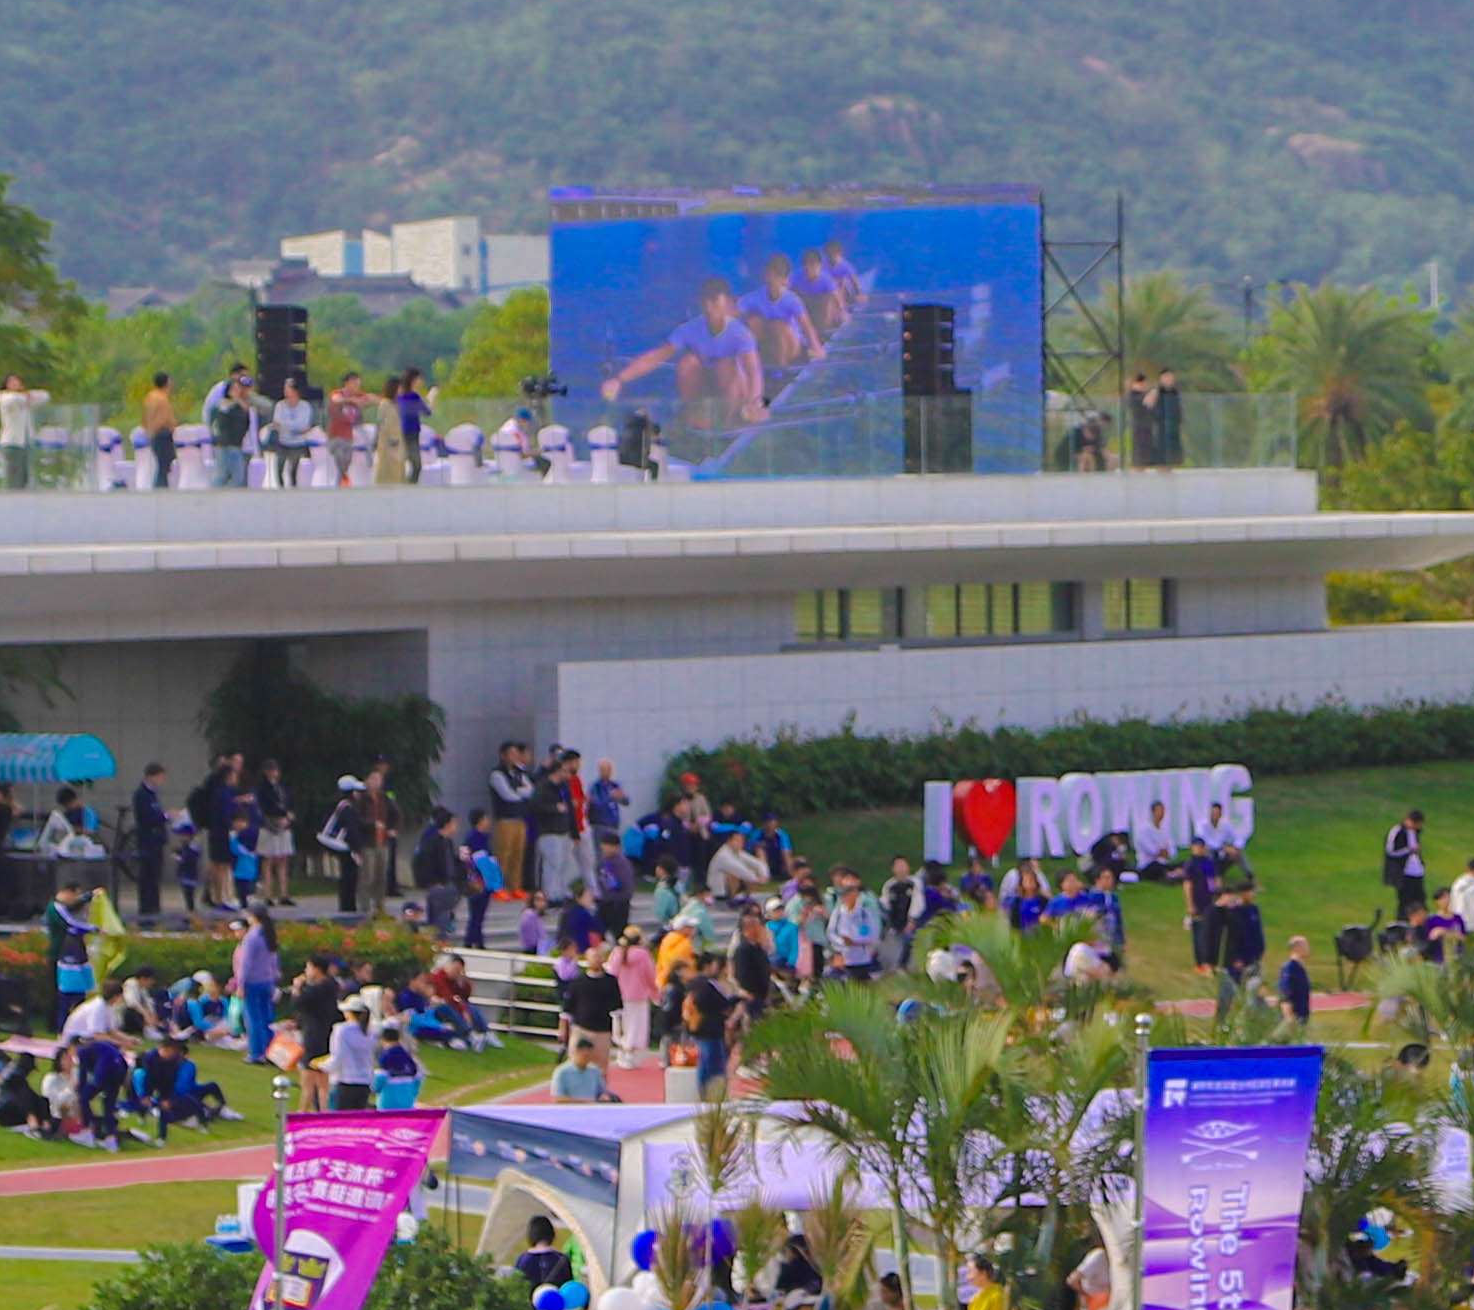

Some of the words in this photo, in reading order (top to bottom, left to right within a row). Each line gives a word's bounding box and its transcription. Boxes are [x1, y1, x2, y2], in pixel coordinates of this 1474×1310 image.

[923, 780, 953, 864] I
[1016, 763, 1255, 858] ROWING
[1218, 1182, 1249, 1256] The
